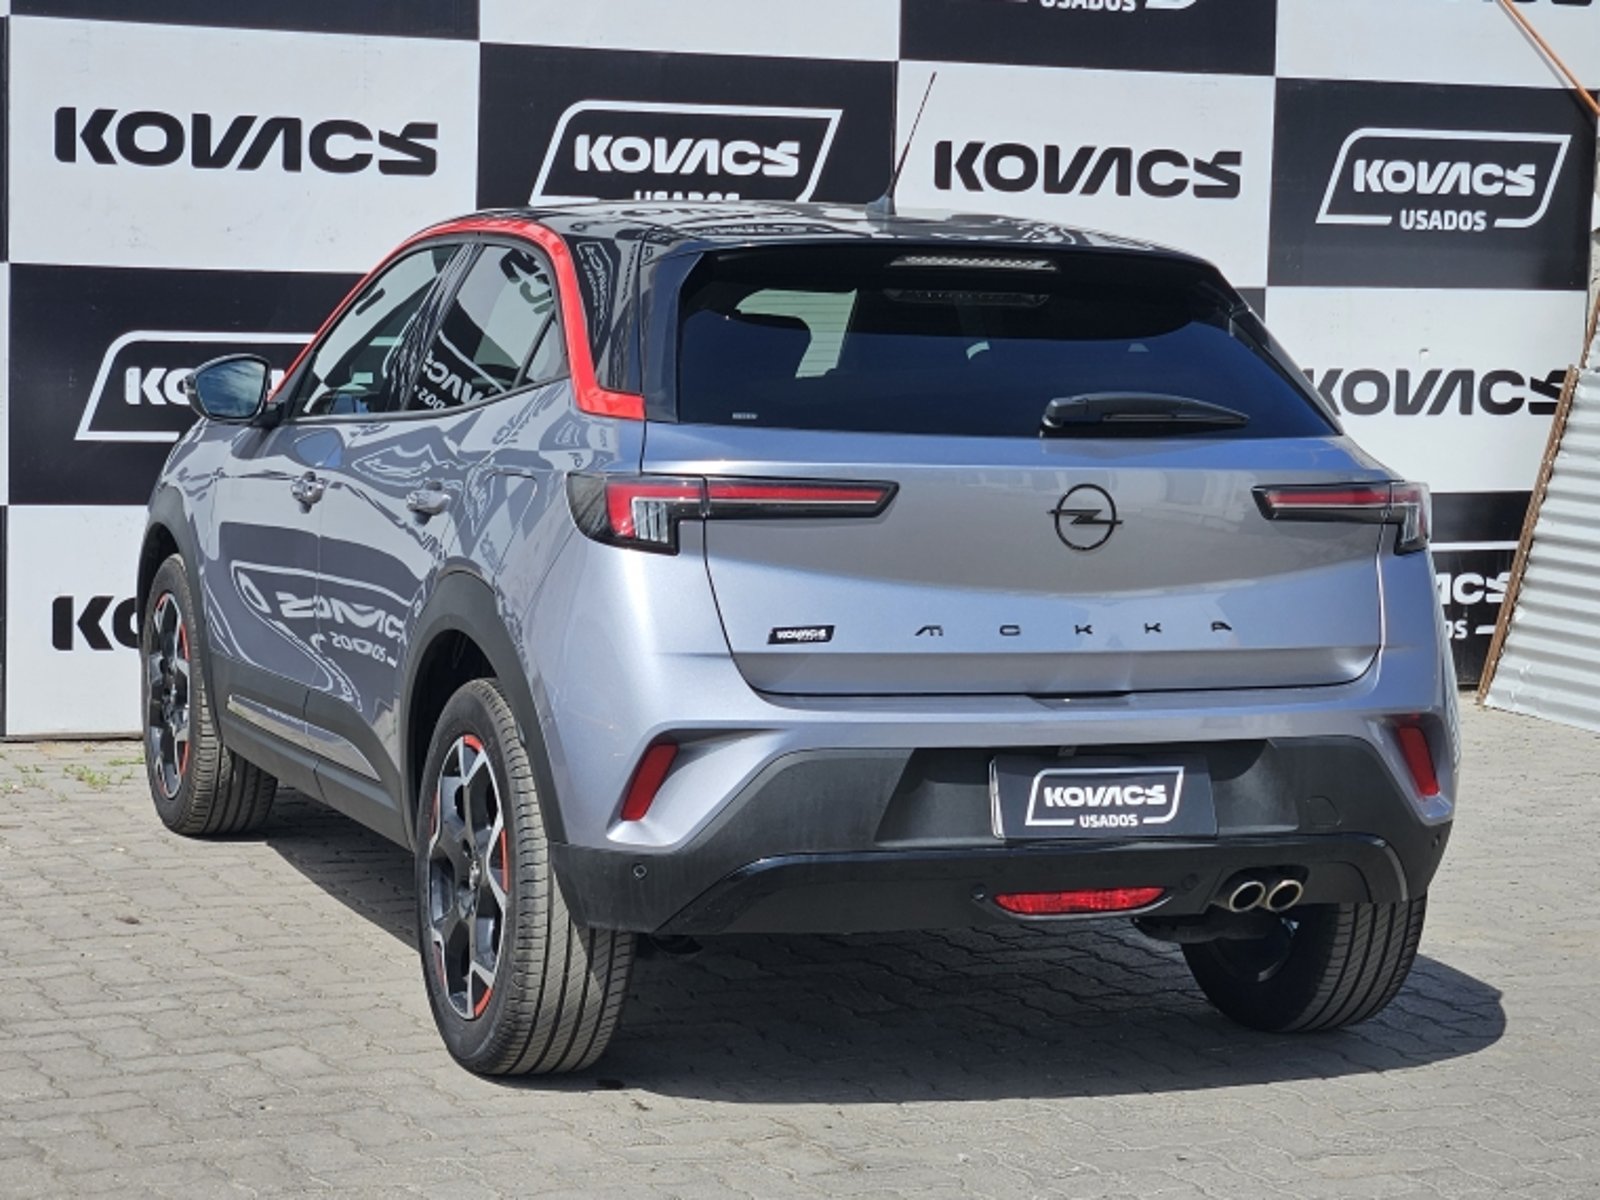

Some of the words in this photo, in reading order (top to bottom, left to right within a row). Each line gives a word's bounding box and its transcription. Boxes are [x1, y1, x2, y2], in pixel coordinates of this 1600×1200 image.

[54, 106, 438, 176] KOVACS
[574, 134, 800, 177] KOVACS
[934, 140, 1242, 199] KOVACS
[1353, 159, 1536, 197] KOVACS
[1399, 209, 1487, 232] USADOS
[1043, 784, 1168, 808] KOVACS
[1078, 813, 1139, 829] USADOS
